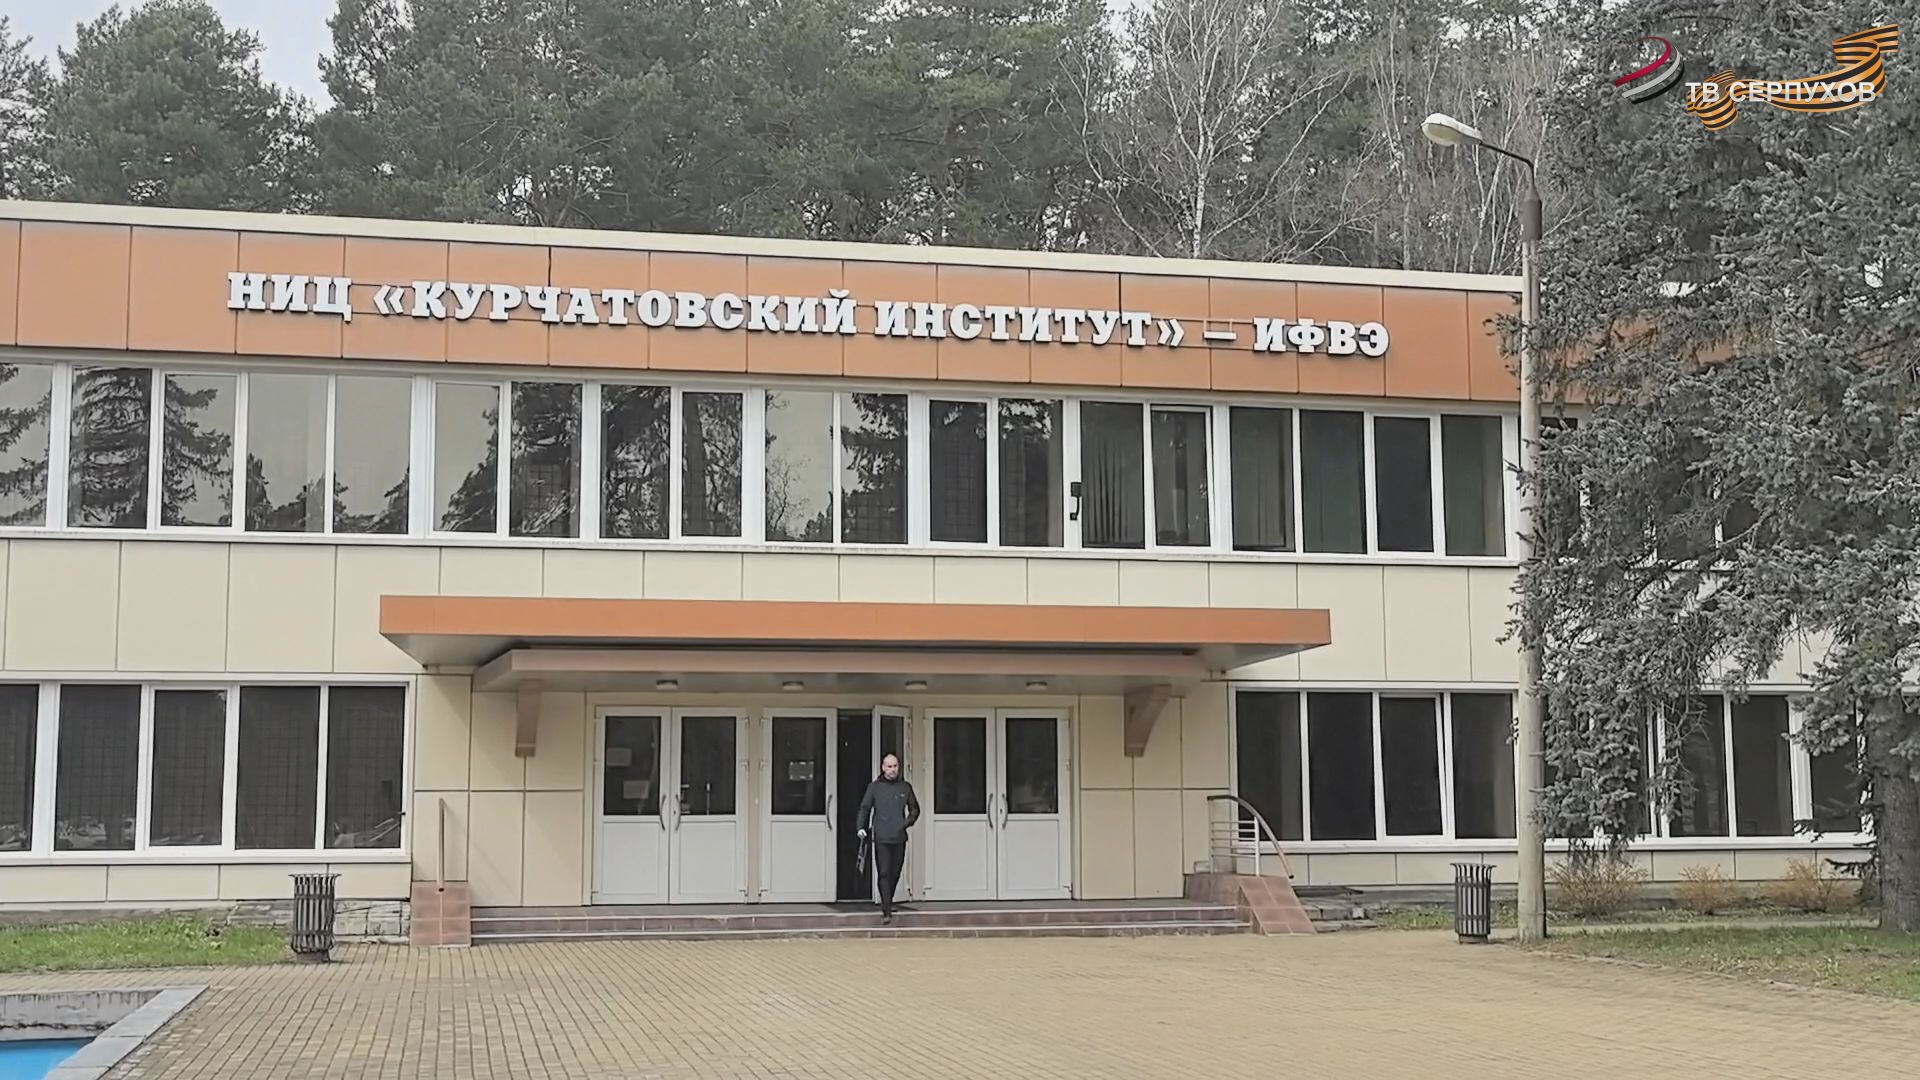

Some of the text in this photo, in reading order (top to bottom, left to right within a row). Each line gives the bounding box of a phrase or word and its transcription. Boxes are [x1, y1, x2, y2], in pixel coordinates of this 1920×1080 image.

[227, 271, 352, 323] НИЦ
[373, 281, 857, 336] «КУРЧАТОВСКИЙ
[874, 300, 1185, 347] ИНСТИТУТ»
[1252, 317, 1390, 357] ИФВЭ
